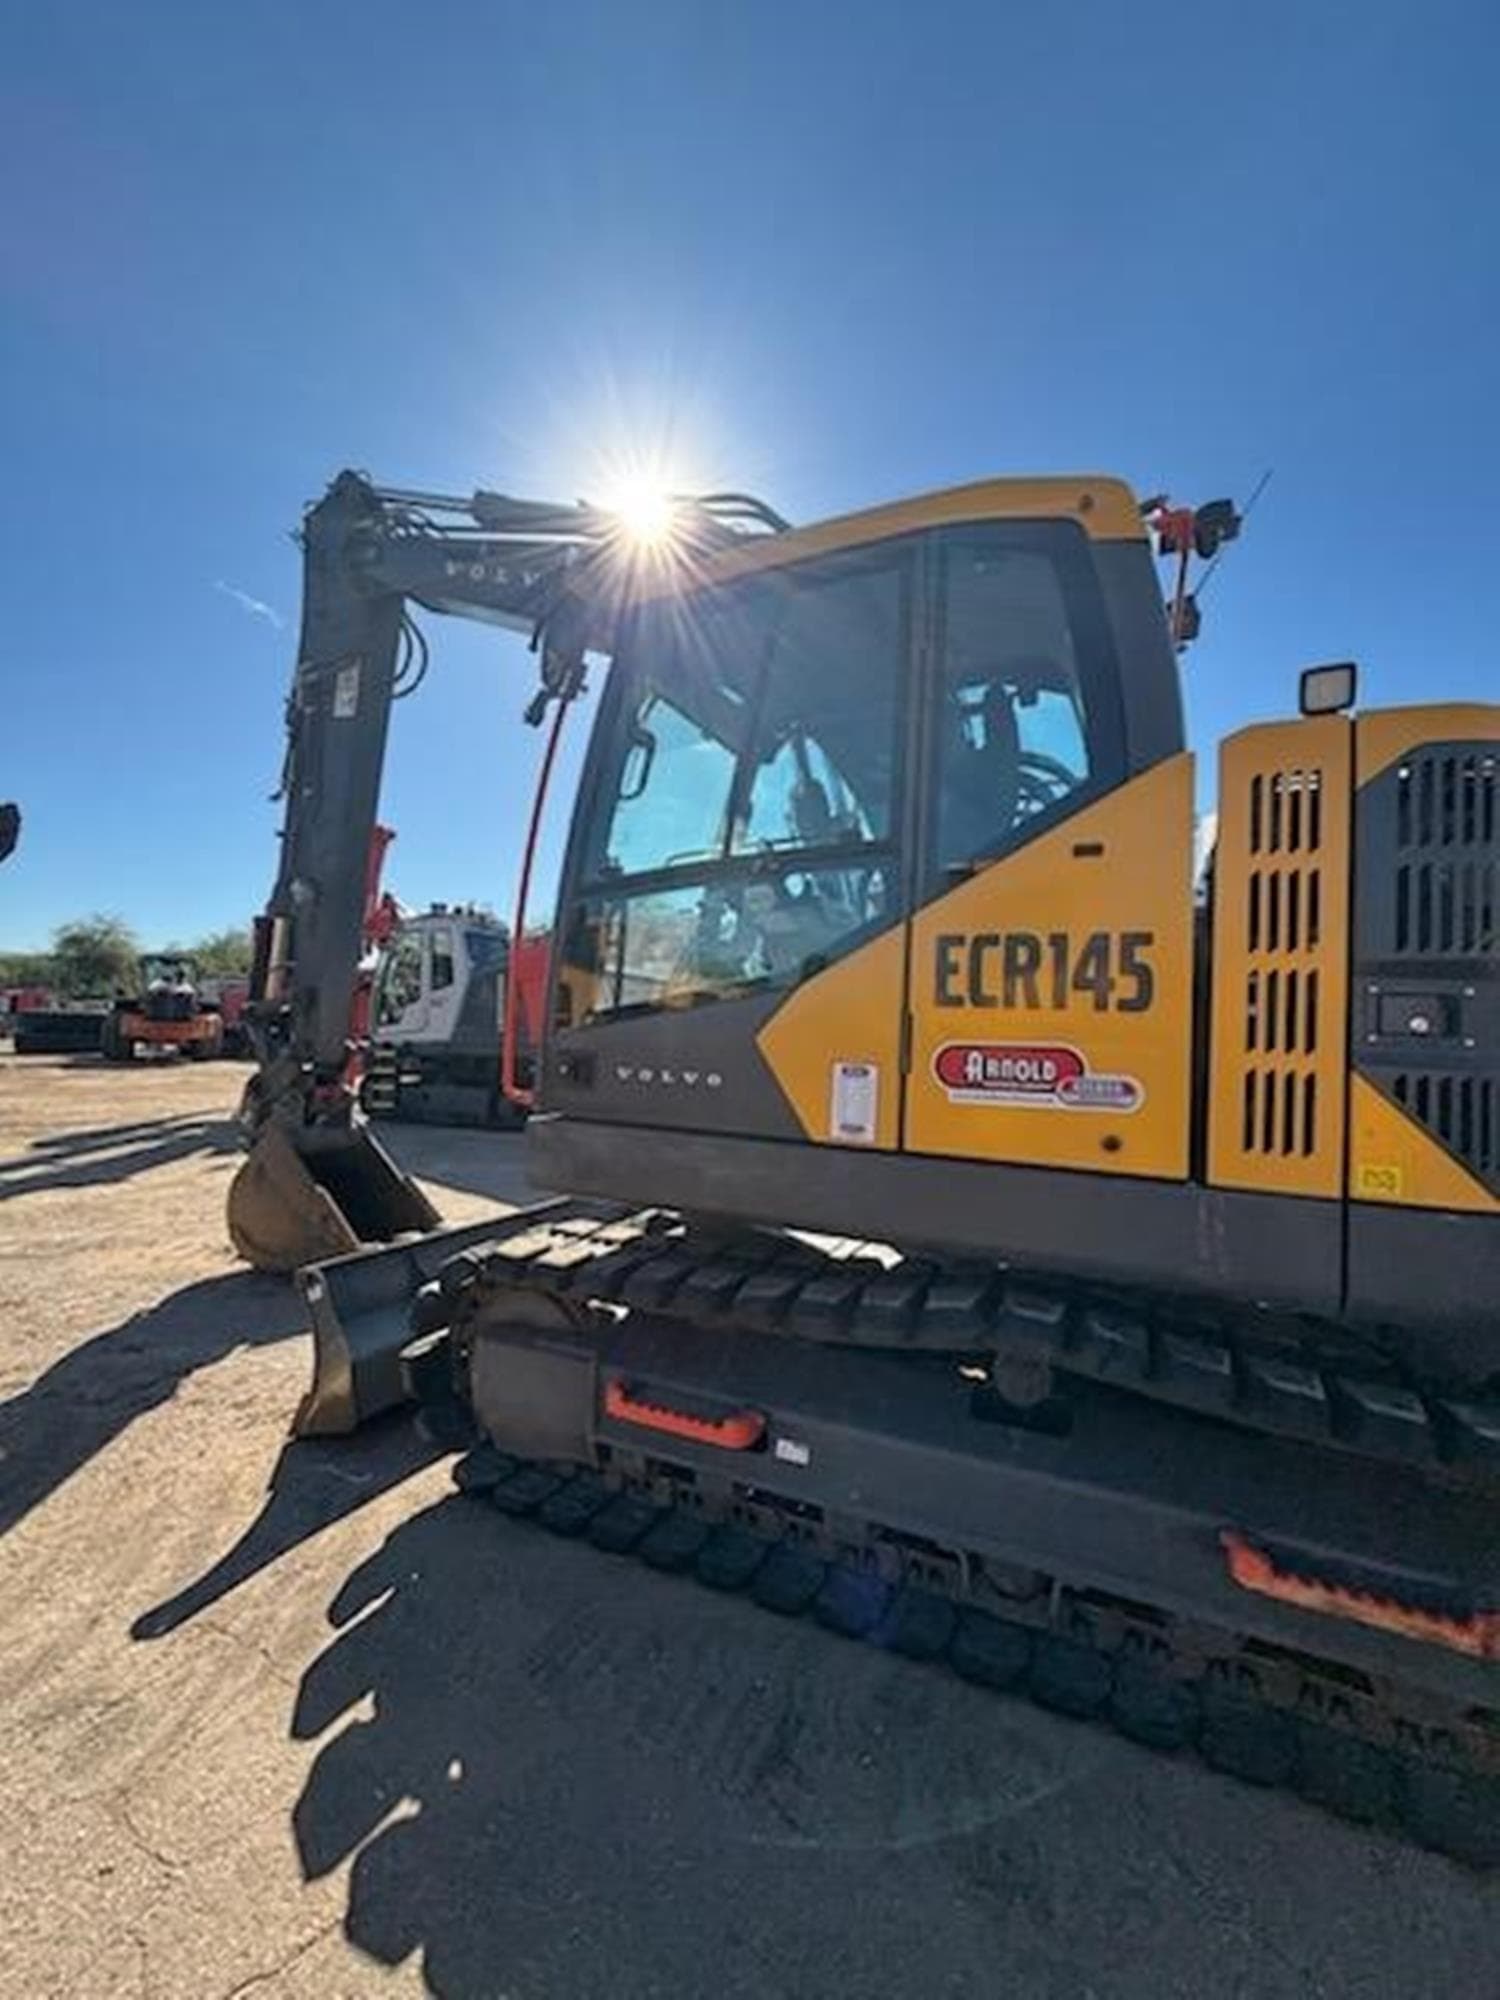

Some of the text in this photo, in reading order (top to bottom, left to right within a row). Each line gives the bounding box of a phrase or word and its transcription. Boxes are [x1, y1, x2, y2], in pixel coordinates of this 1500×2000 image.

[446, 561, 543, 588] VOLV
[935, 931, 1154, 1012] ECR145
[616, 1066, 723, 1087] VOLVO
